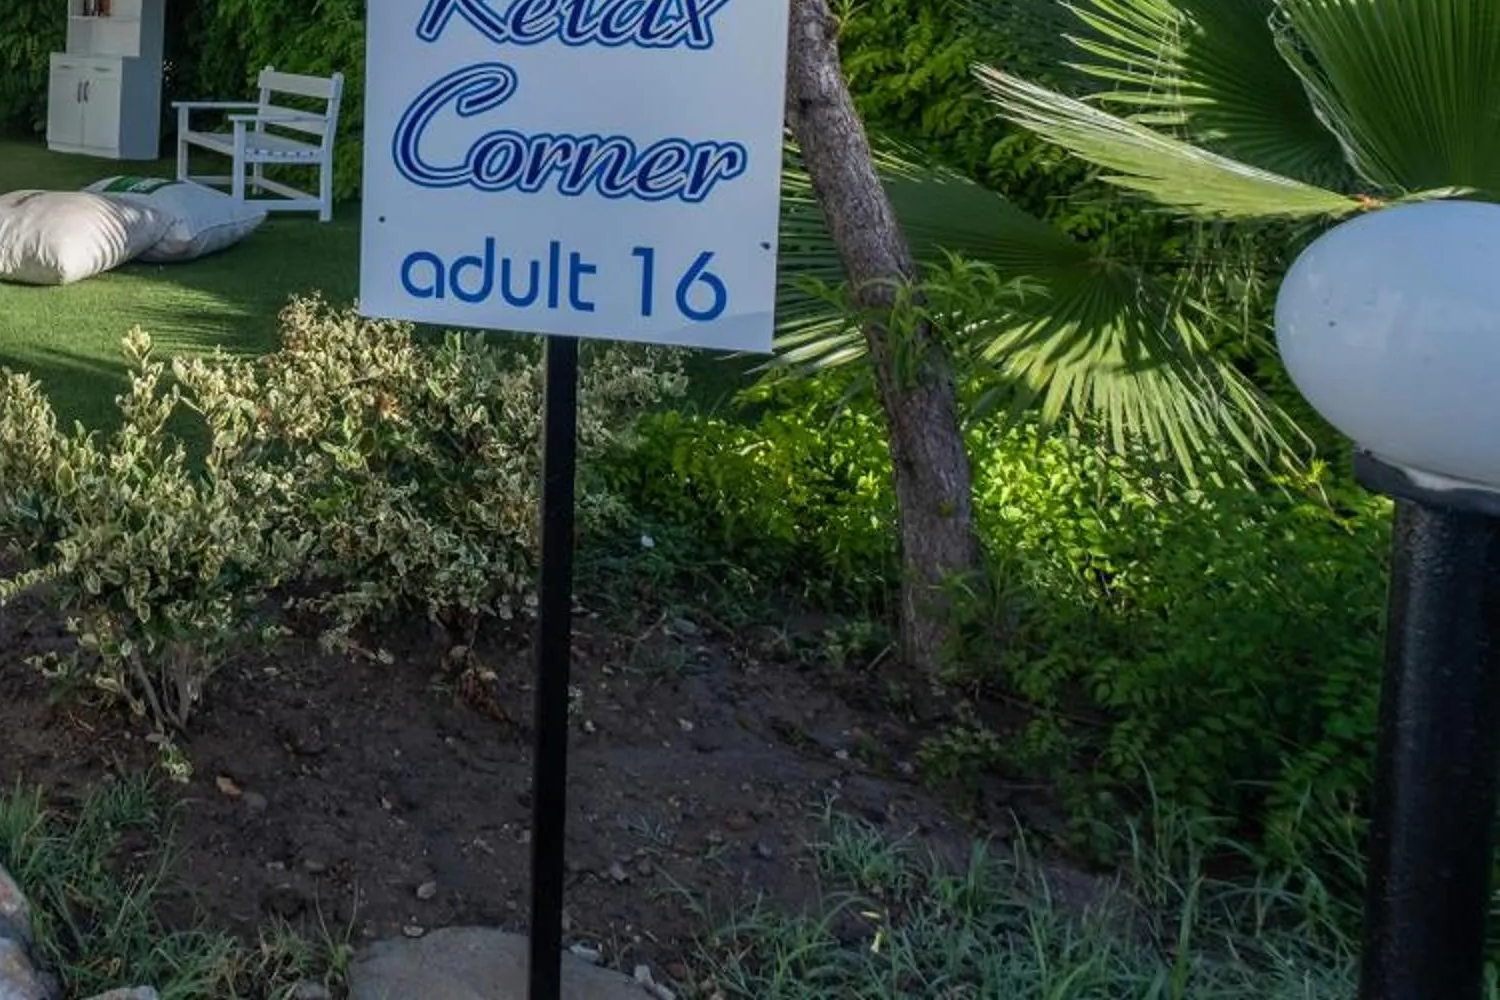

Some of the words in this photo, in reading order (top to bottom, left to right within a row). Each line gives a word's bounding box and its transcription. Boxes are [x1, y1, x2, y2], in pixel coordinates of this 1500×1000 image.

[392, 62, 748, 203] Corner
[400, 236, 597, 313] adult
[631, 246, 728, 323] 16
